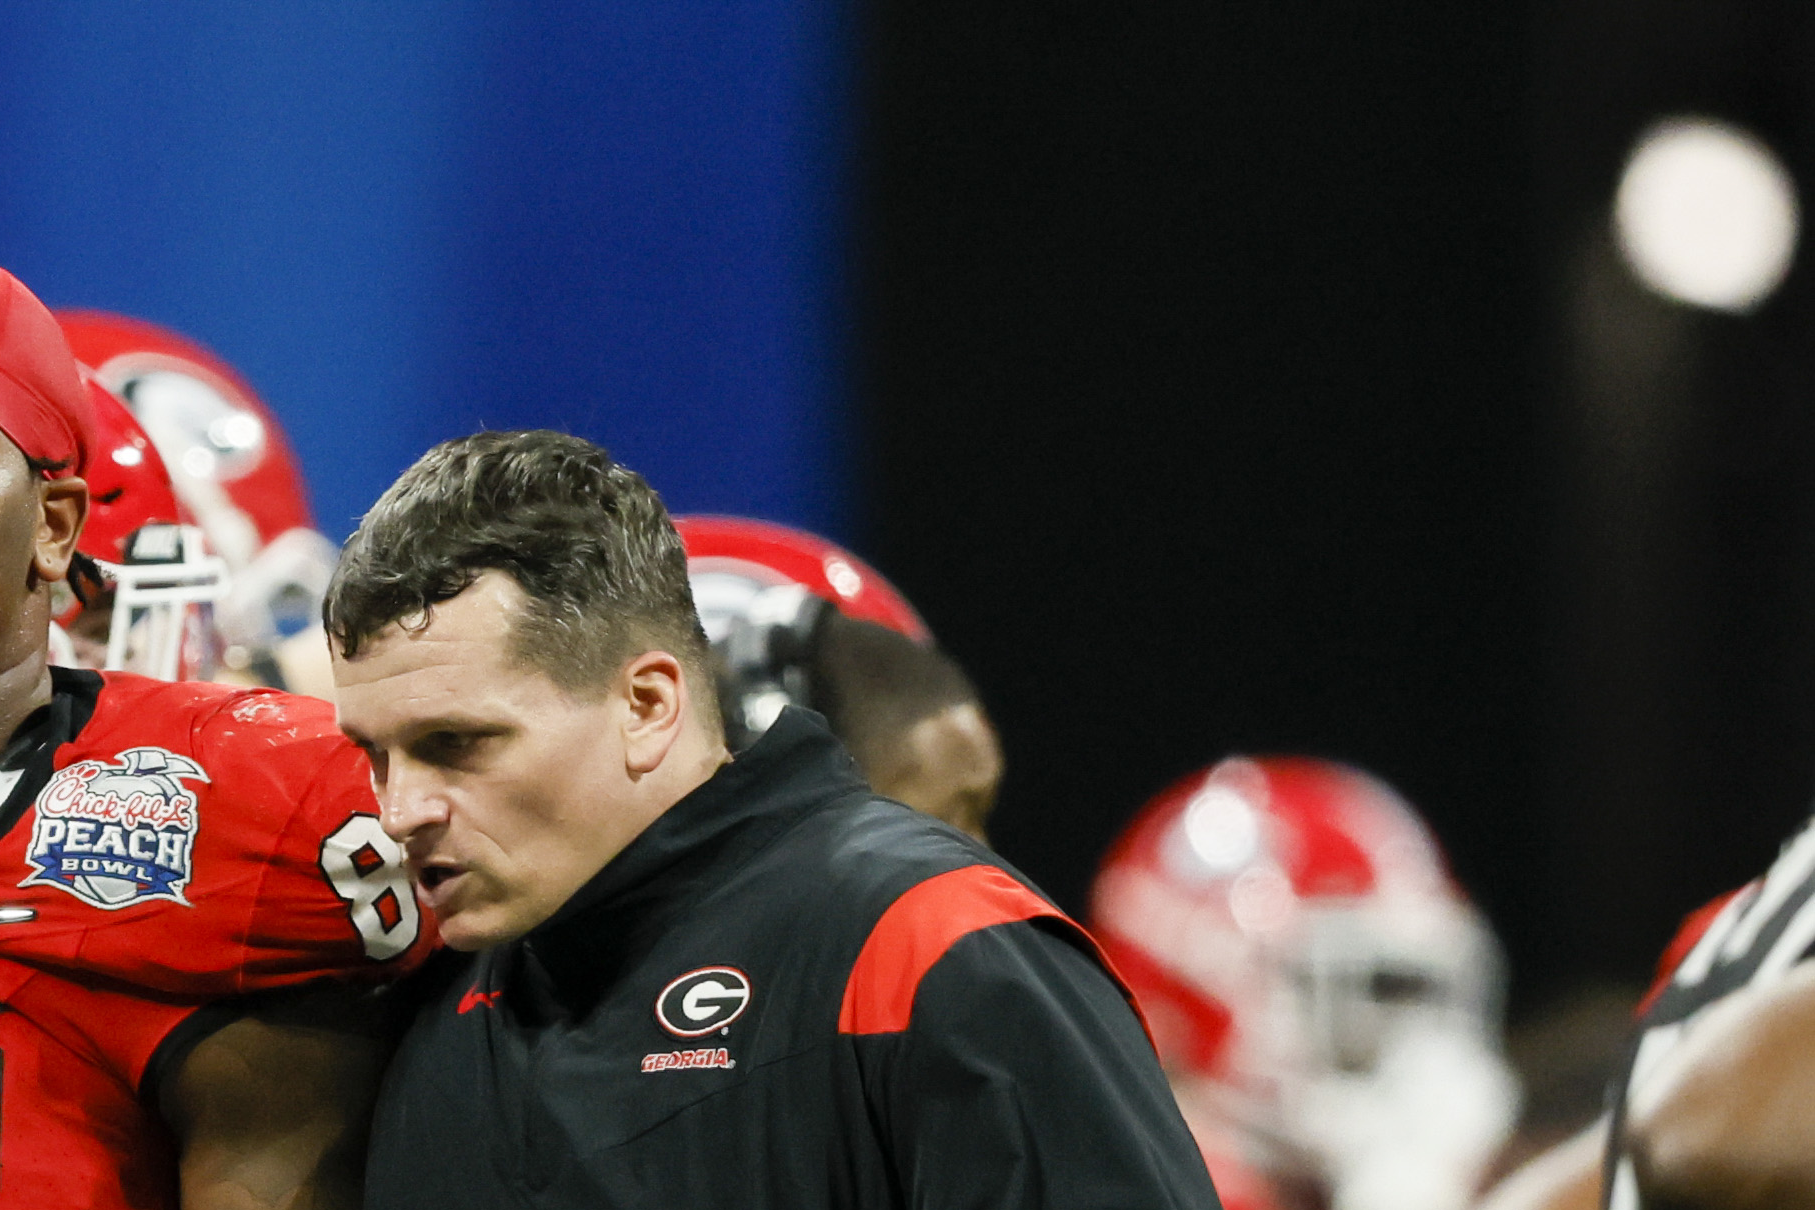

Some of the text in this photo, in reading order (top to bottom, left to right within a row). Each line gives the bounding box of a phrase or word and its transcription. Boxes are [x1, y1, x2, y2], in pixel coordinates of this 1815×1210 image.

[44, 774, 193, 829] Chick-fil-A
[32, 817, 188, 876] PEACH
[60, 856, 155, 882] BOWL
[658, 968, 749, 1034] G
[640, 1047, 730, 1074] GEORGIA
